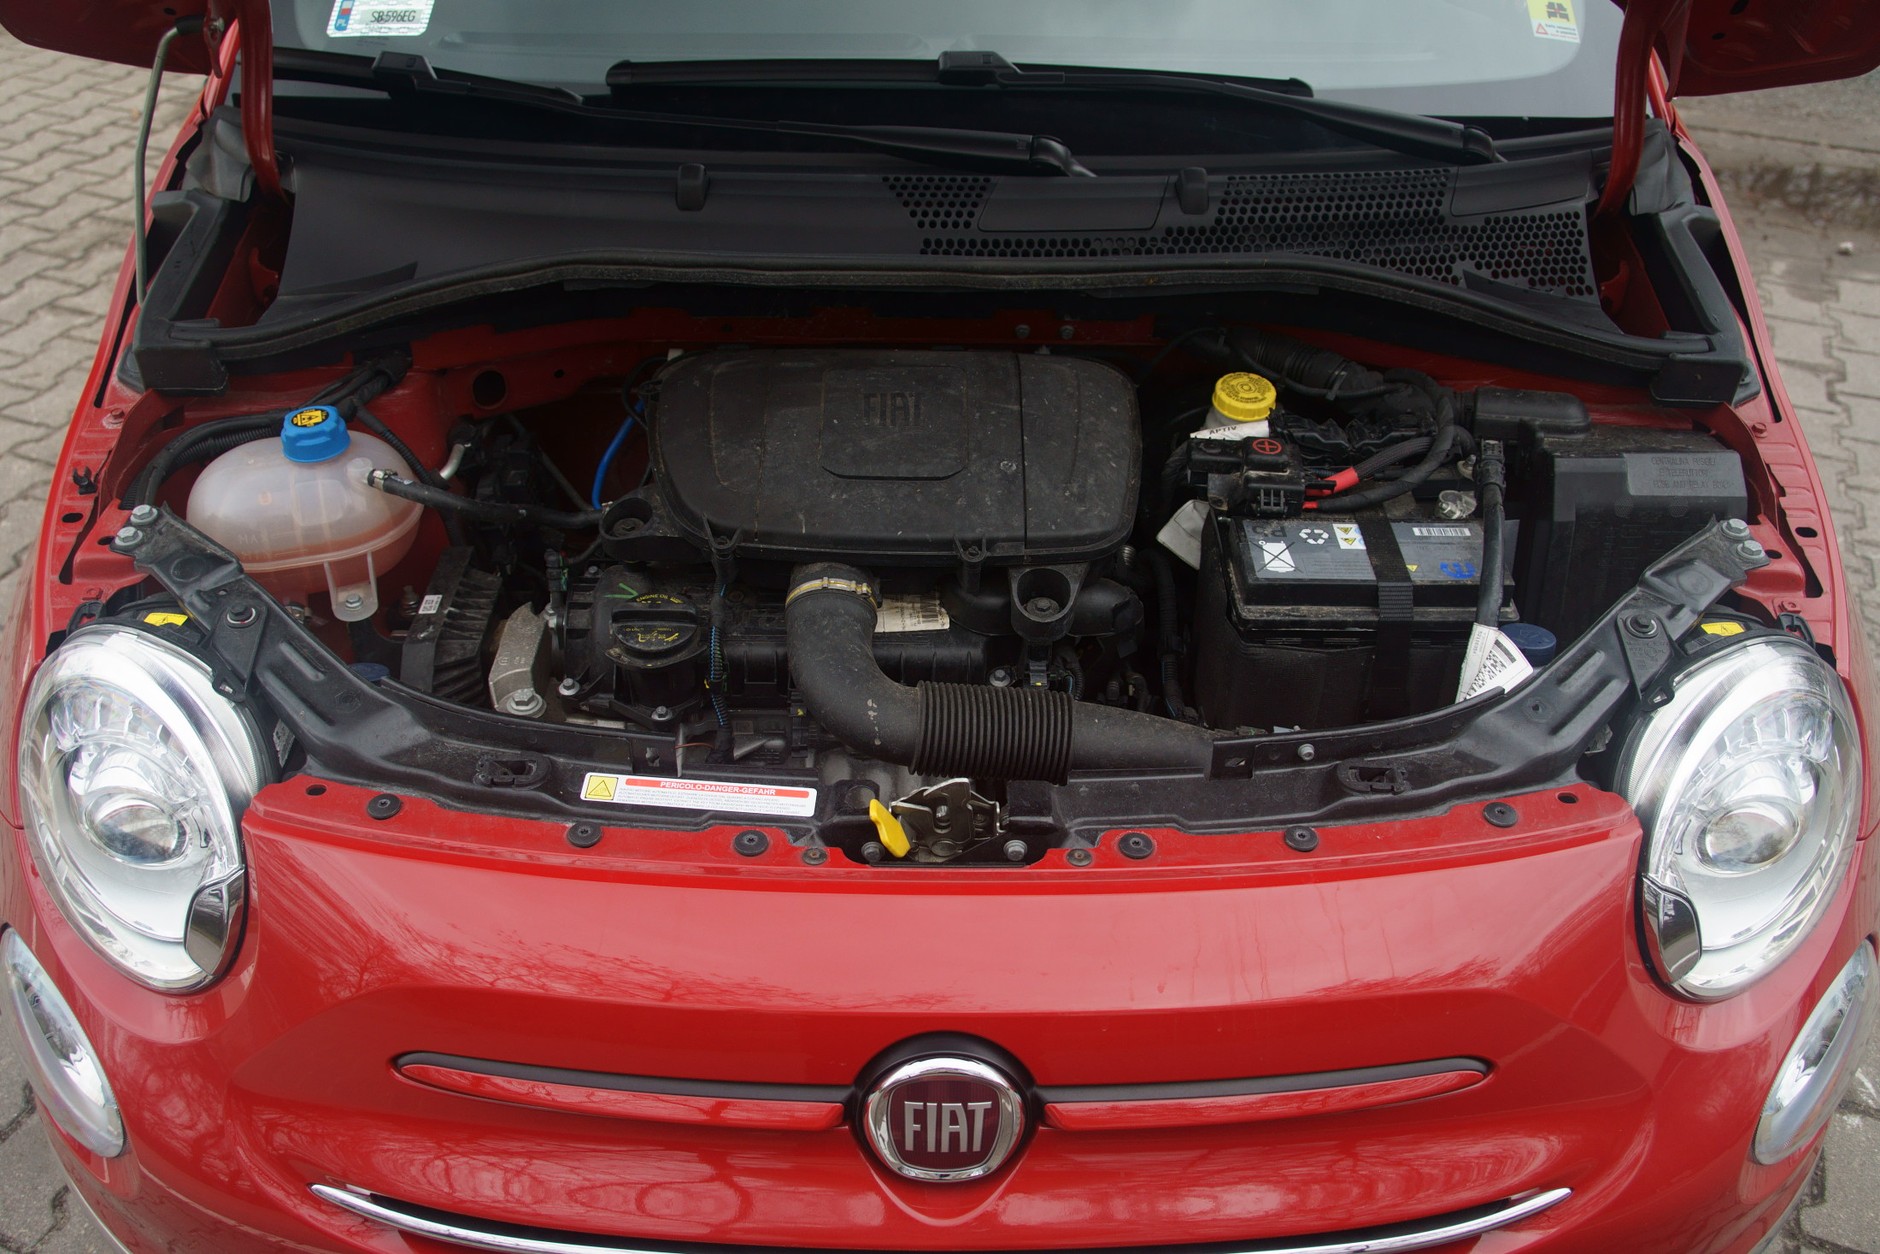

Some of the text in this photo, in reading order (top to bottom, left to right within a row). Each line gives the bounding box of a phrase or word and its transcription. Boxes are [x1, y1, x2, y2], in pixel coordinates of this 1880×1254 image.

[863, 391, 925, 427] FIAT
[660, 780, 776, 796] PERICOLO-DANGER-GEFAHR
[904, 1101, 993, 1153] FIAT
